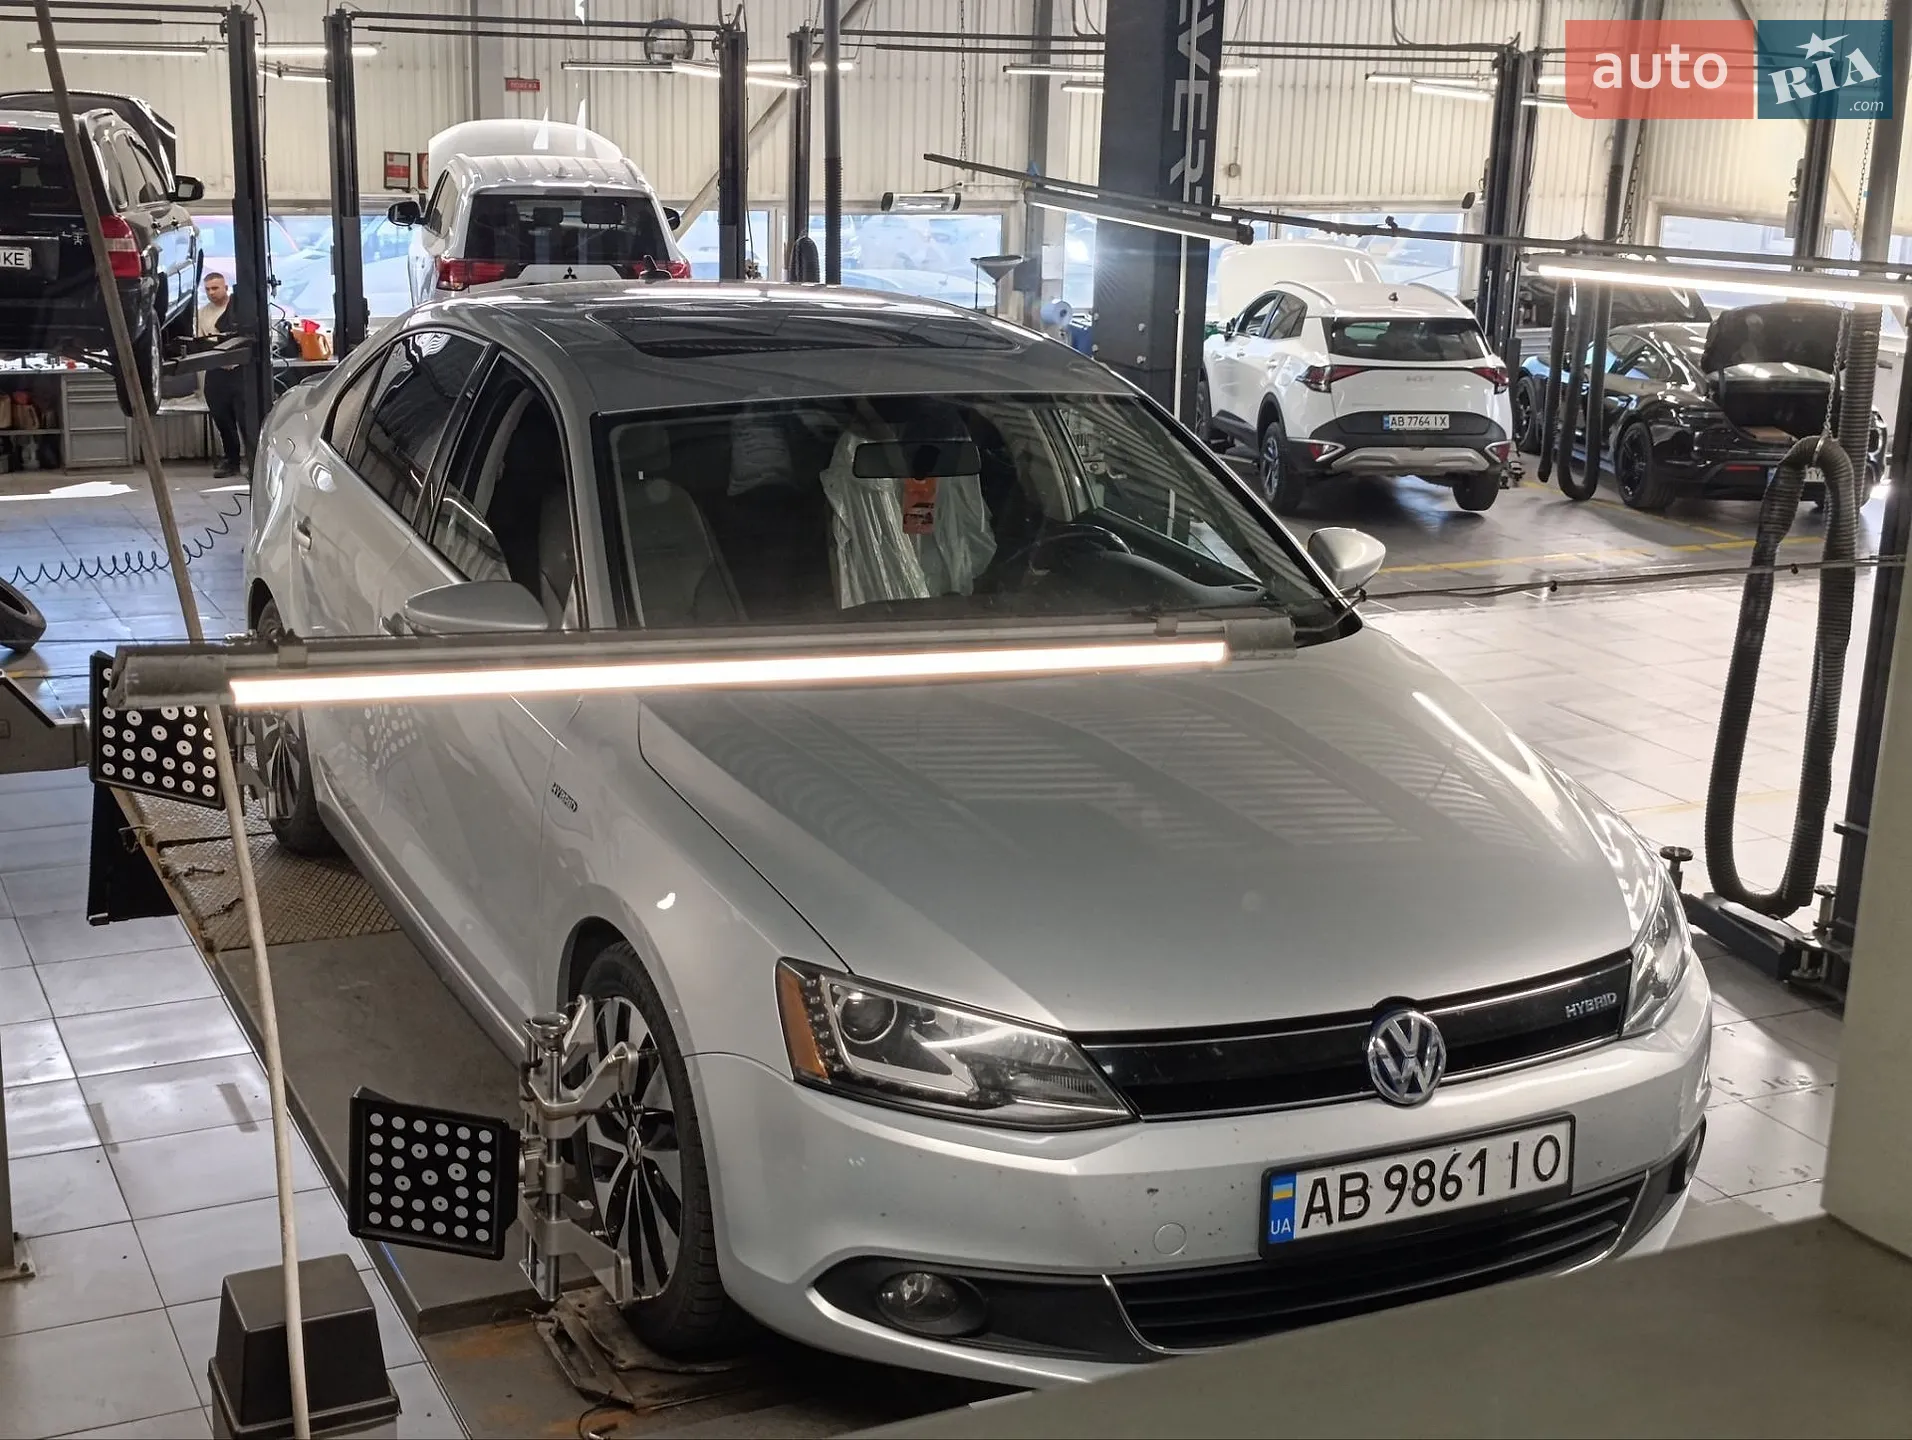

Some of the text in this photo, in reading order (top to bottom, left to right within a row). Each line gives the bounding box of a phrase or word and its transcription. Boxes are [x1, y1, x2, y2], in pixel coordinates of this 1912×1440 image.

[1391, 416, 1405, 427] AB
[1408, 416, 1430, 427] 7764
[1565, 992, 1617, 1018] HYBRID
[1301, 1134, 1561, 1229] AB 9861 IO
[1271, 1217, 1291, 1235] UA
